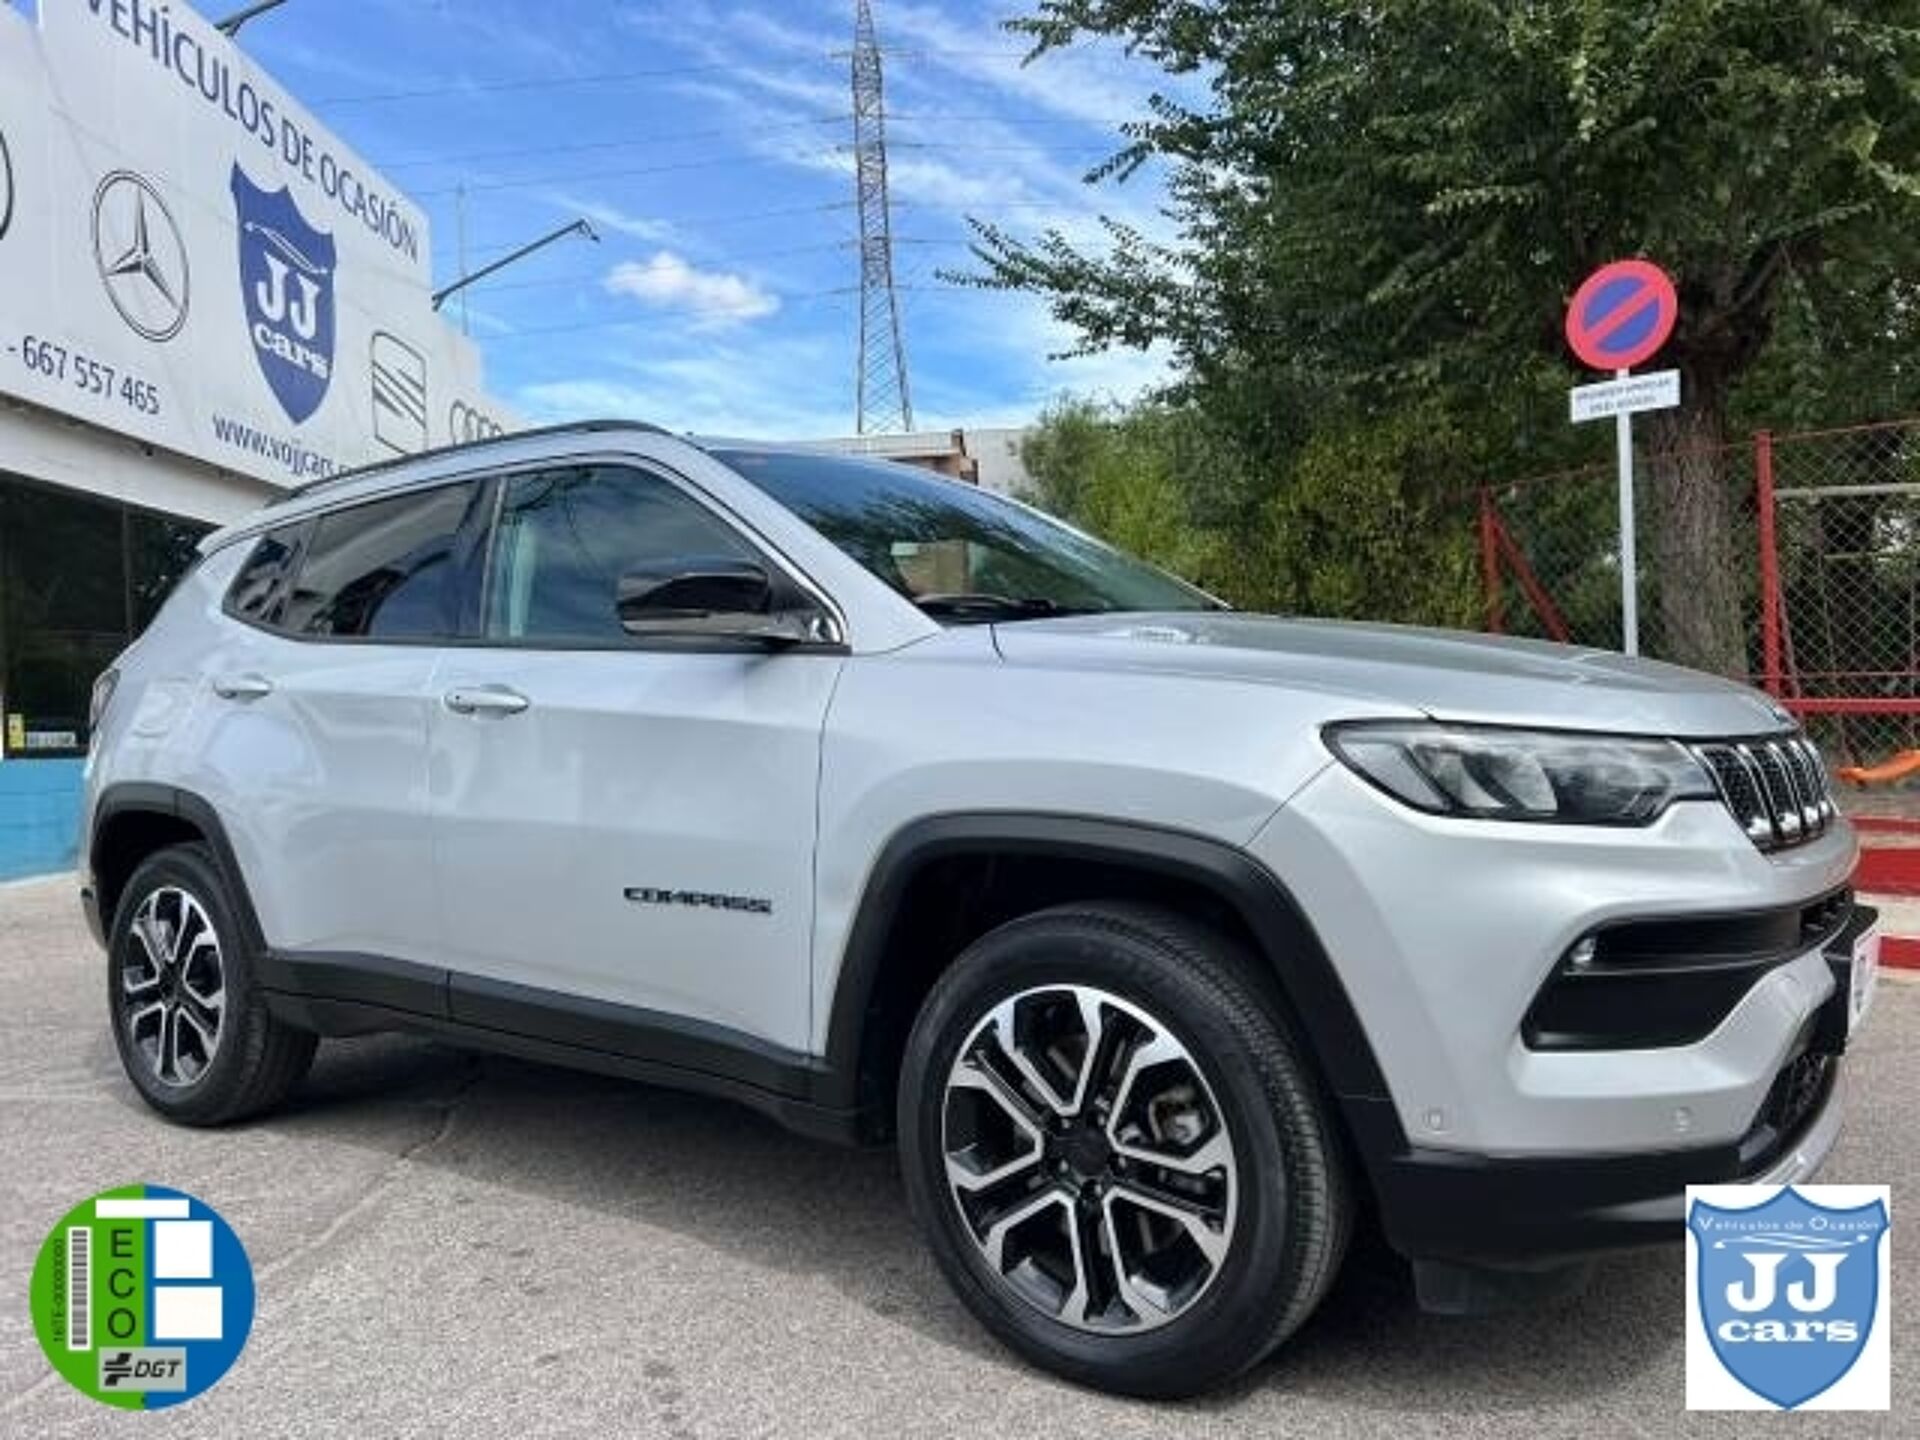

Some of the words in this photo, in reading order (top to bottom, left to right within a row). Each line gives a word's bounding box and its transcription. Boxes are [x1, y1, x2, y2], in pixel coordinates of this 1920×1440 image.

[89, 0, 275, 148] EHÍCULOS
[282, 117, 315, 182] DE
[320, 153, 418, 264] OCASIÓN
[257, 250, 320, 340] JJ
[23, 335, 67, 379] 667
[74, 356, 115, 398] 557
[120, 375, 160, 415] 465
[254, 322, 329, 379] cars
[624, 887, 772, 914] COMPASS
